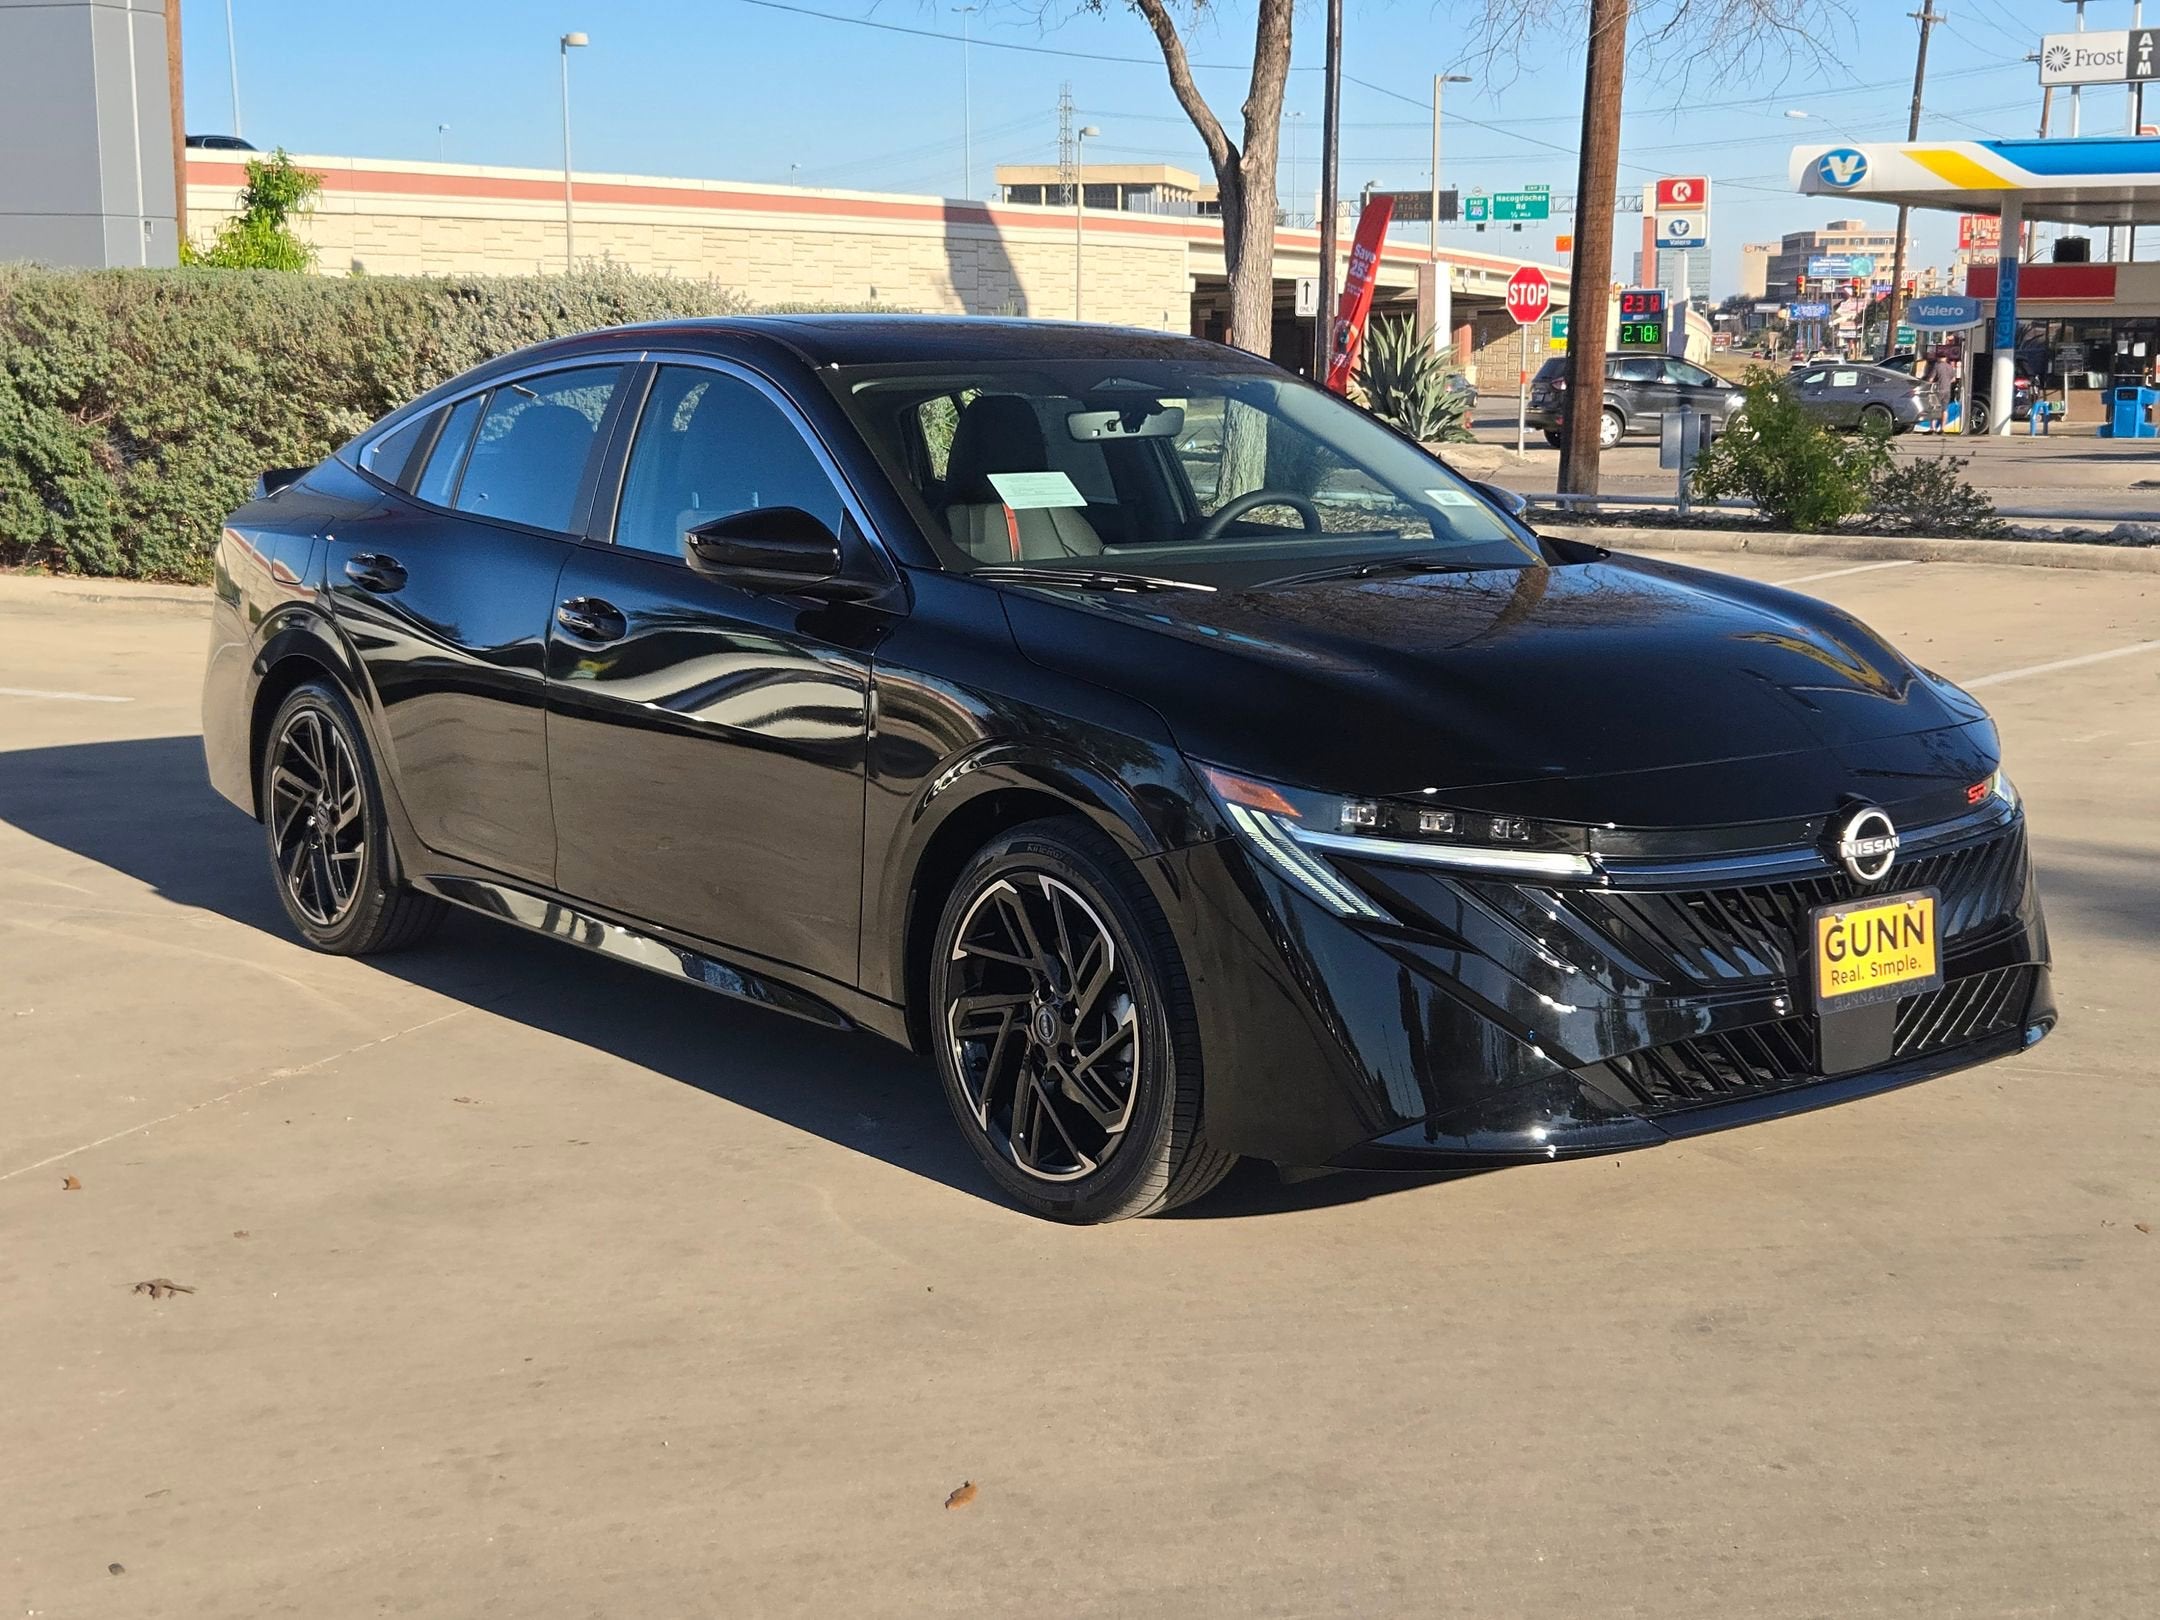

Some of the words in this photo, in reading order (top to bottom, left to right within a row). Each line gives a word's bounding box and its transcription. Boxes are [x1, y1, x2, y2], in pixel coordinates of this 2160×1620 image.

[2074, 48, 2124, 67] Frost
[2136, 32, 2154, 76] ATM
[1496, 194, 1546, 203] Nacogdoches
[1354, 243, 1377, 264] Save
[1508, 283, 1548, 306] STOP
[1299, 305, 1314, 313] ONLY
[1918, 305, 1964, 317] Valero
[1998, 278, 2013, 348] Valero
[1845, 836, 1900, 856] NISSAN
[1825, 910, 1925, 962] GUNN
[1831, 964, 1865, 987] Real.
[1870, 954, 1922, 978] Simple.
